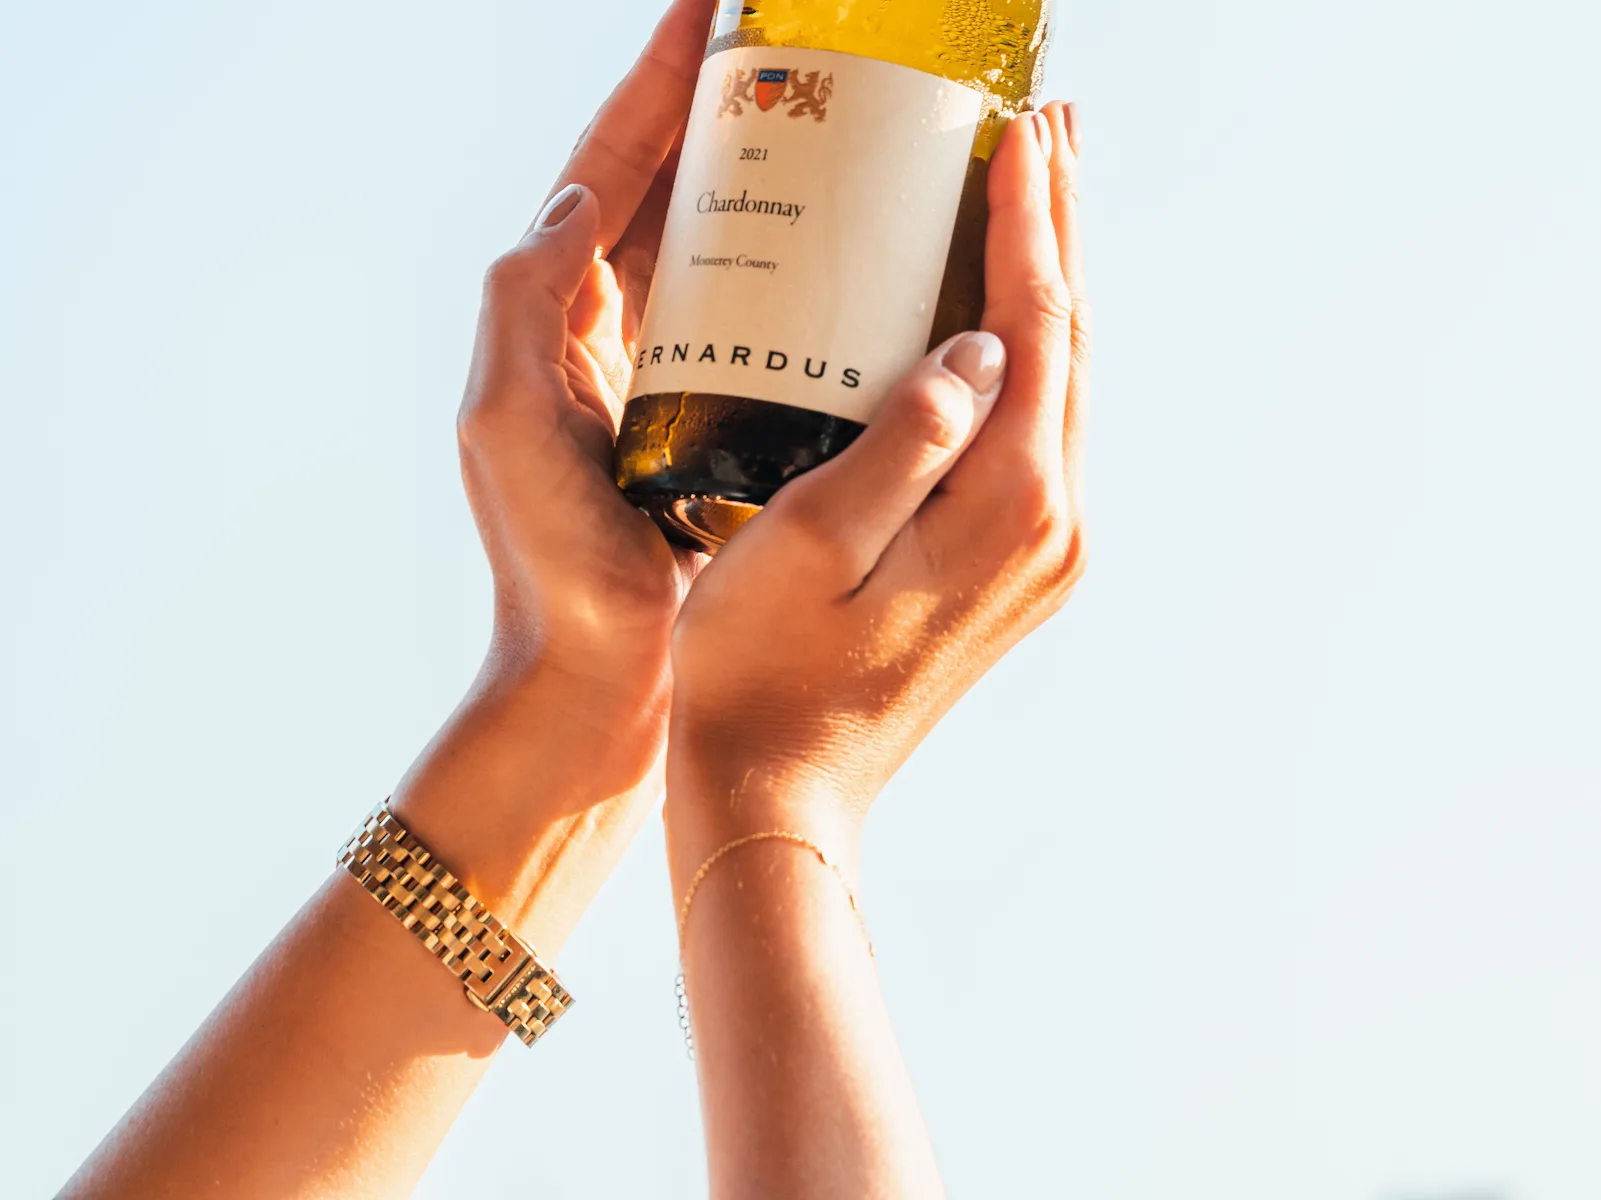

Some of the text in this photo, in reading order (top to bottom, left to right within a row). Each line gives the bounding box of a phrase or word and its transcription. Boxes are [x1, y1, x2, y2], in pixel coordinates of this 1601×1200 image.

[759, 71, 785, 81] PON
[738, 147, 769, 161] 2021
[696, 189, 807, 226] Chardonnay
[689, 253, 780, 275] Monterey County
[637, 342, 862, 389] ERNARDUS
